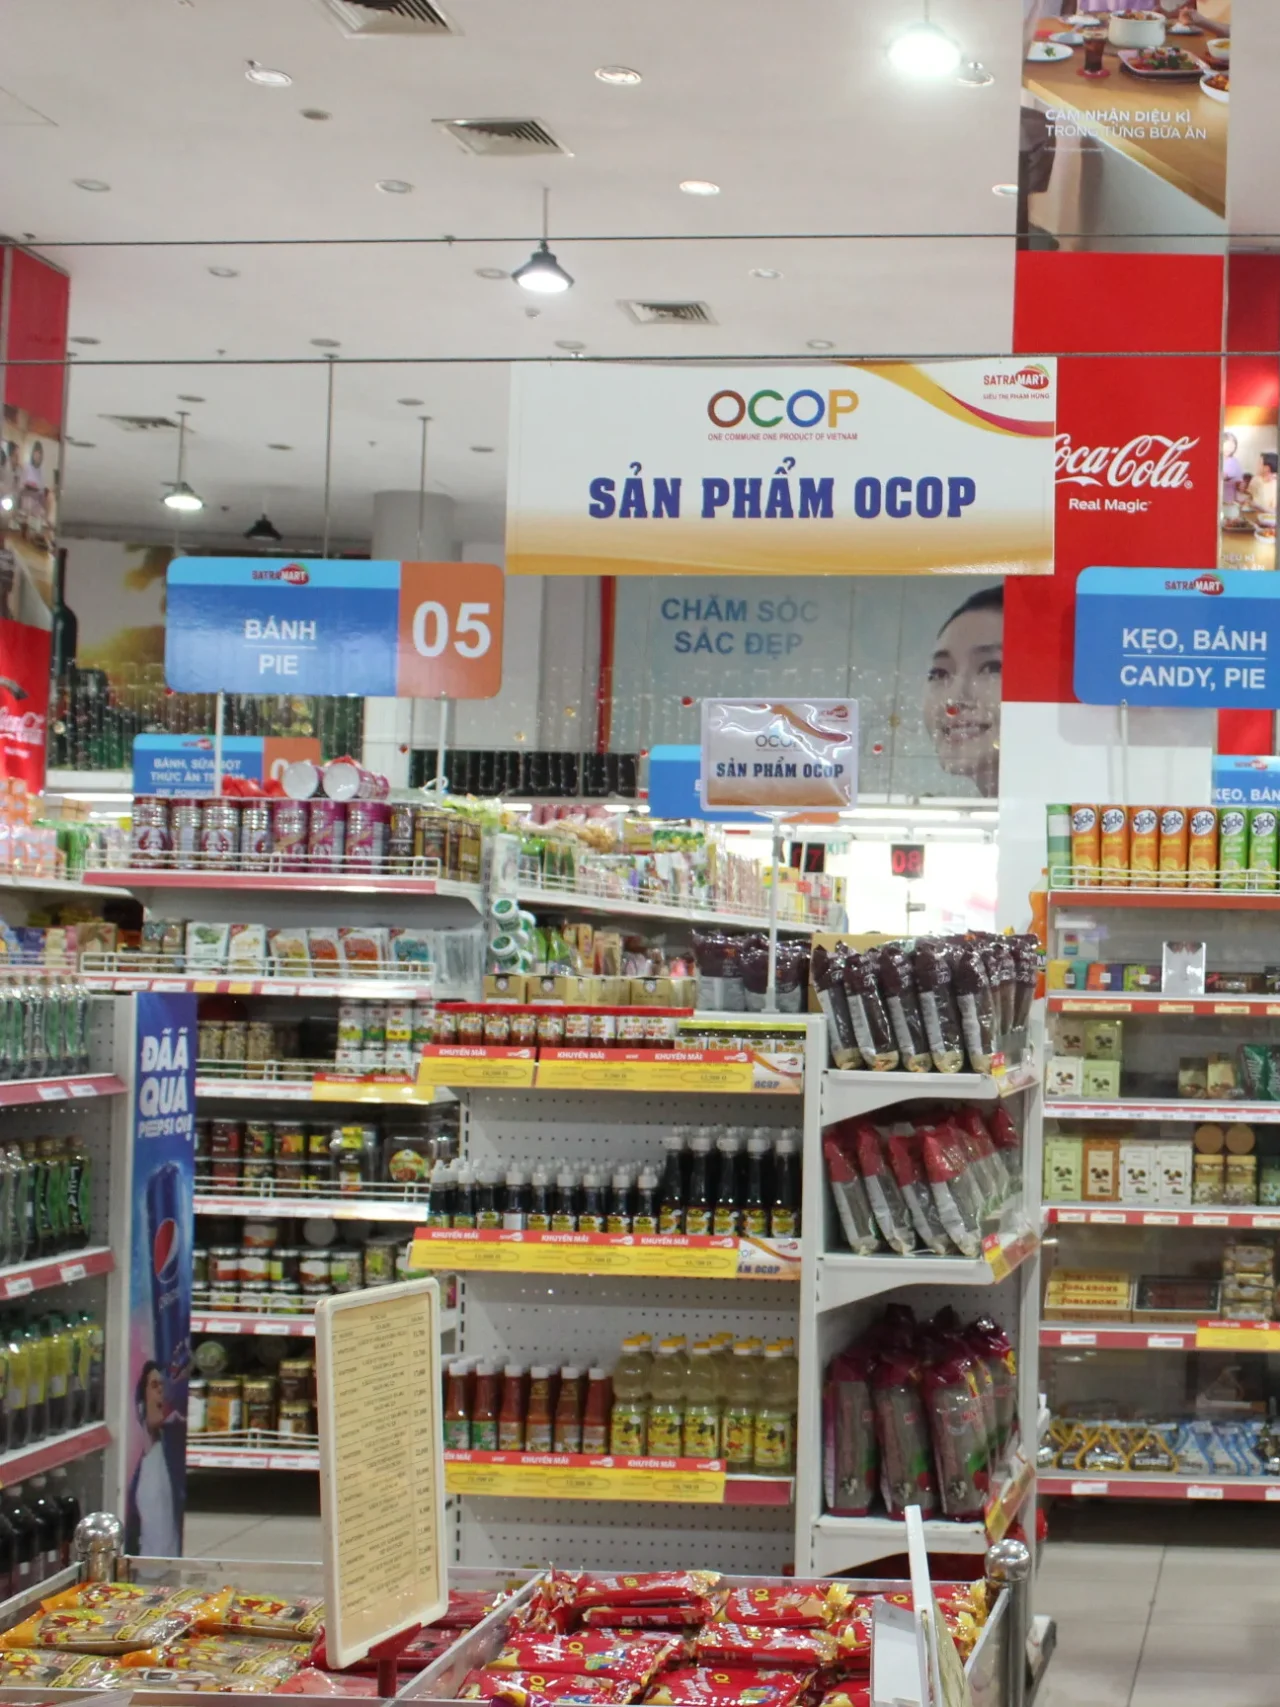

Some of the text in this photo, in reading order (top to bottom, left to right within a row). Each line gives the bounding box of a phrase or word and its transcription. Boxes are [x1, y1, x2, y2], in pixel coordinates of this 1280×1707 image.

[1085, 107, 1130, 126] NHẬN
[1135, 108, 1170, 125] DIỆU
[1045, 124, 1099, 137] TRONG
[1150, 125, 1181, 139] BỮA
[1185, 124, 1206, 140] ĂN
[983, 374, 1045, 385] SATRAMART
[707, 389, 859, 428] OCOP
[708, 433, 858, 441] ONE COMMUNE ONE PRODUCT OF VIETNAM
[588, 456, 976, 518] SẢN PHẨM OCOP
[1069, 498, 1100, 511] Real
[1165, 577, 1221, 592] SATRAMART
[661, 593, 747, 622] CHĂM
[244, 614, 316, 642] BÁNH
[412, 600, 492, 659] 05
[1122, 625, 1267, 654] KẸO, BÁNH
[744, 632, 803, 660] ĐẸP
[258, 653, 298, 675] PIE
[1120, 664, 1266, 692] CANDY, PIE
[716, 756, 844, 778] SẢN PHẨM OCOP
[139, 1069, 189, 1118] QUÁ
